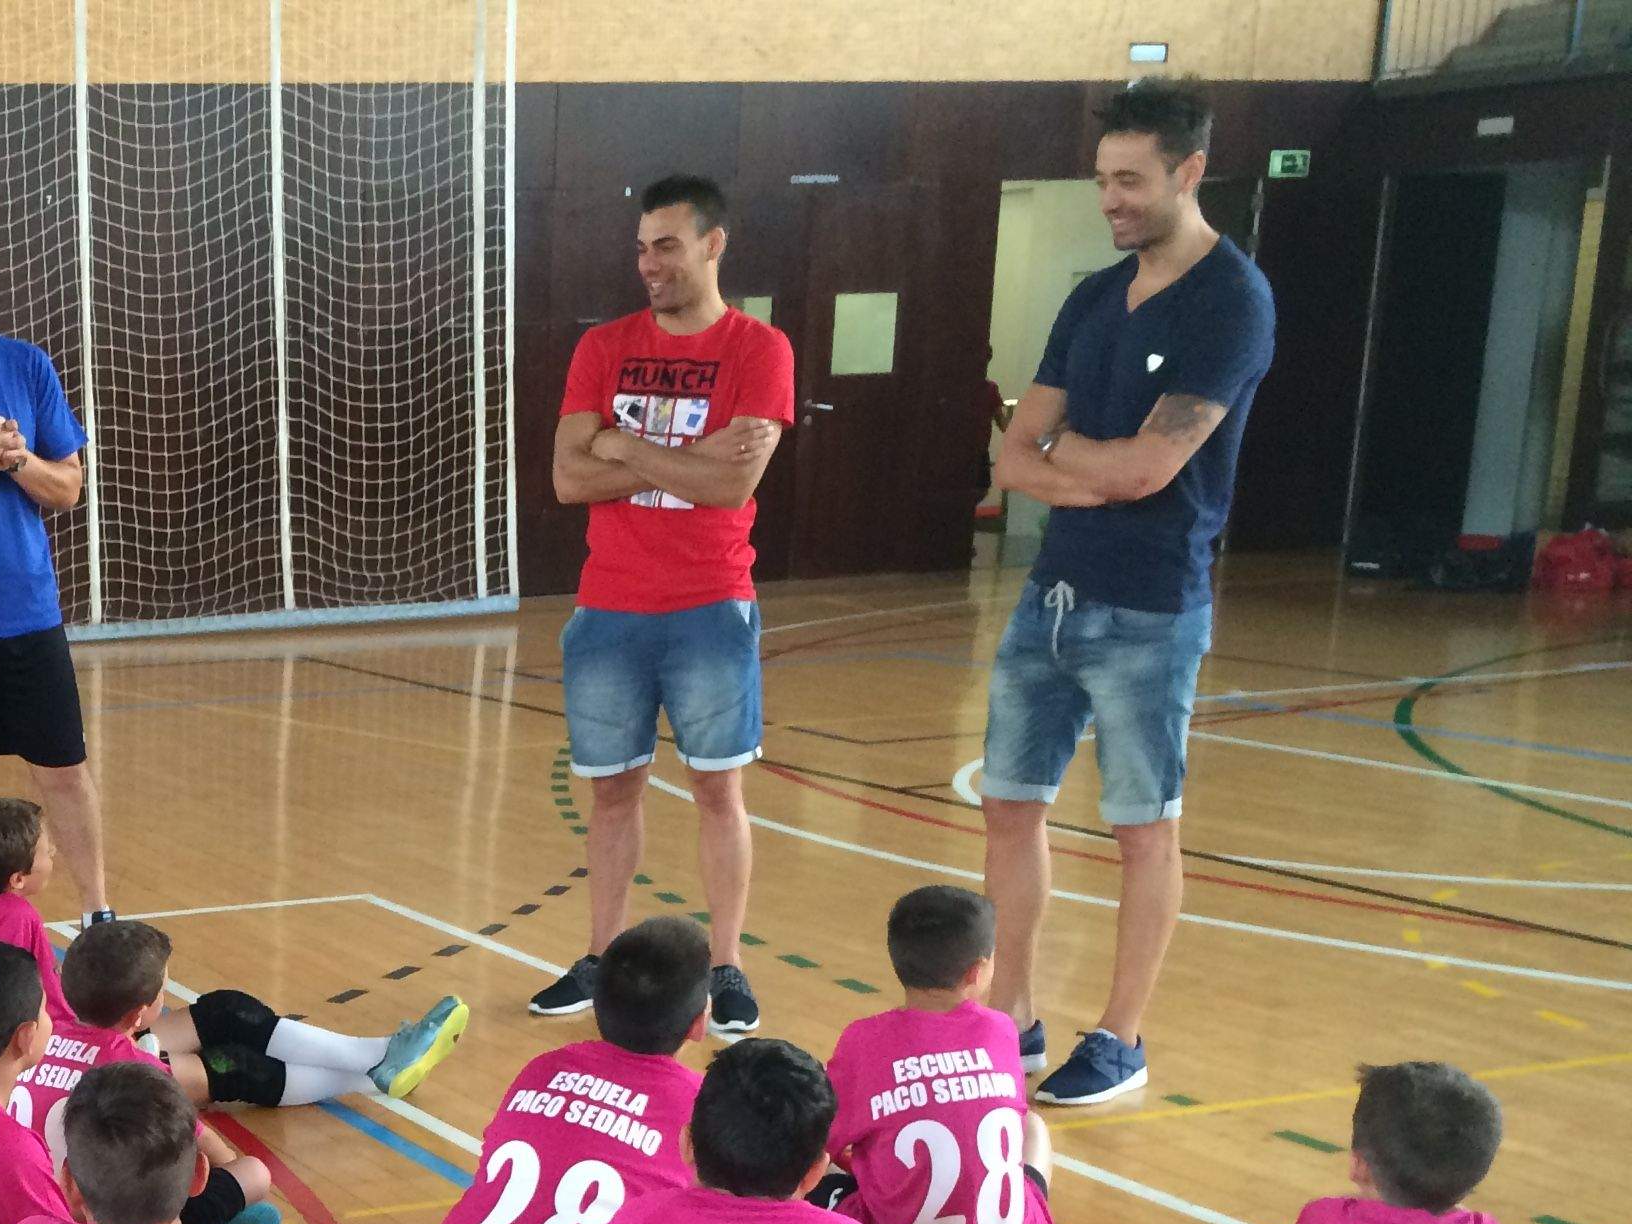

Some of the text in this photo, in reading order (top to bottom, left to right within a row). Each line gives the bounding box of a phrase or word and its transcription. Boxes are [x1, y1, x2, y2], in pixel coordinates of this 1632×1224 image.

[45, 1034, 101, 1066] CUELA
[891, 1048, 994, 1084] ESCUELA
[35, 1063, 83, 1092] SEDA
[547, 1071, 650, 1117] ESCUELA
[870, 1082, 928, 1121] PACO
[506, 1089, 663, 1157] PACO SEDANO
